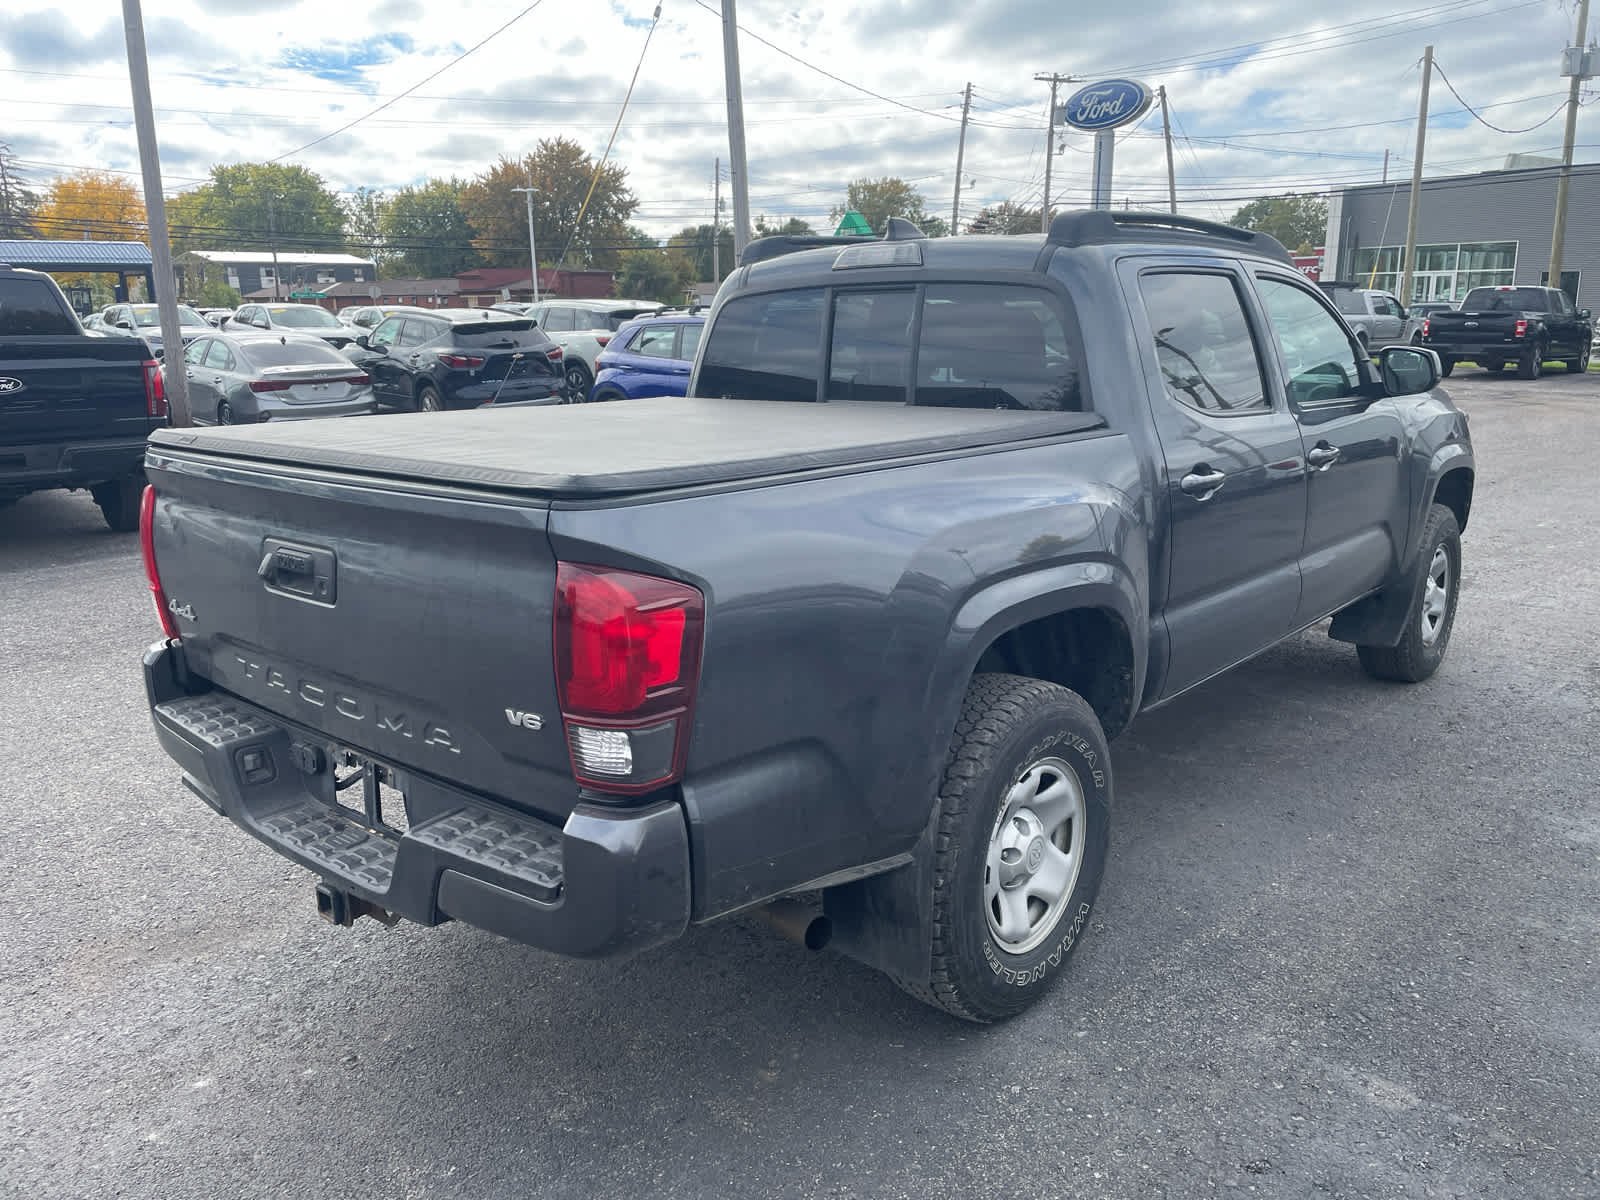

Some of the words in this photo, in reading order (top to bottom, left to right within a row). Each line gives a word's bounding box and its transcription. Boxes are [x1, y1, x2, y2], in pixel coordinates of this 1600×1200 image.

[1077, 88, 1126, 121] Ford
[169, 599, 197, 623] 4x4
[236, 655, 461, 754] TACOMA
[504, 708, 542, 730] V6
[983, 903, 1090, 986] WRANGLER
